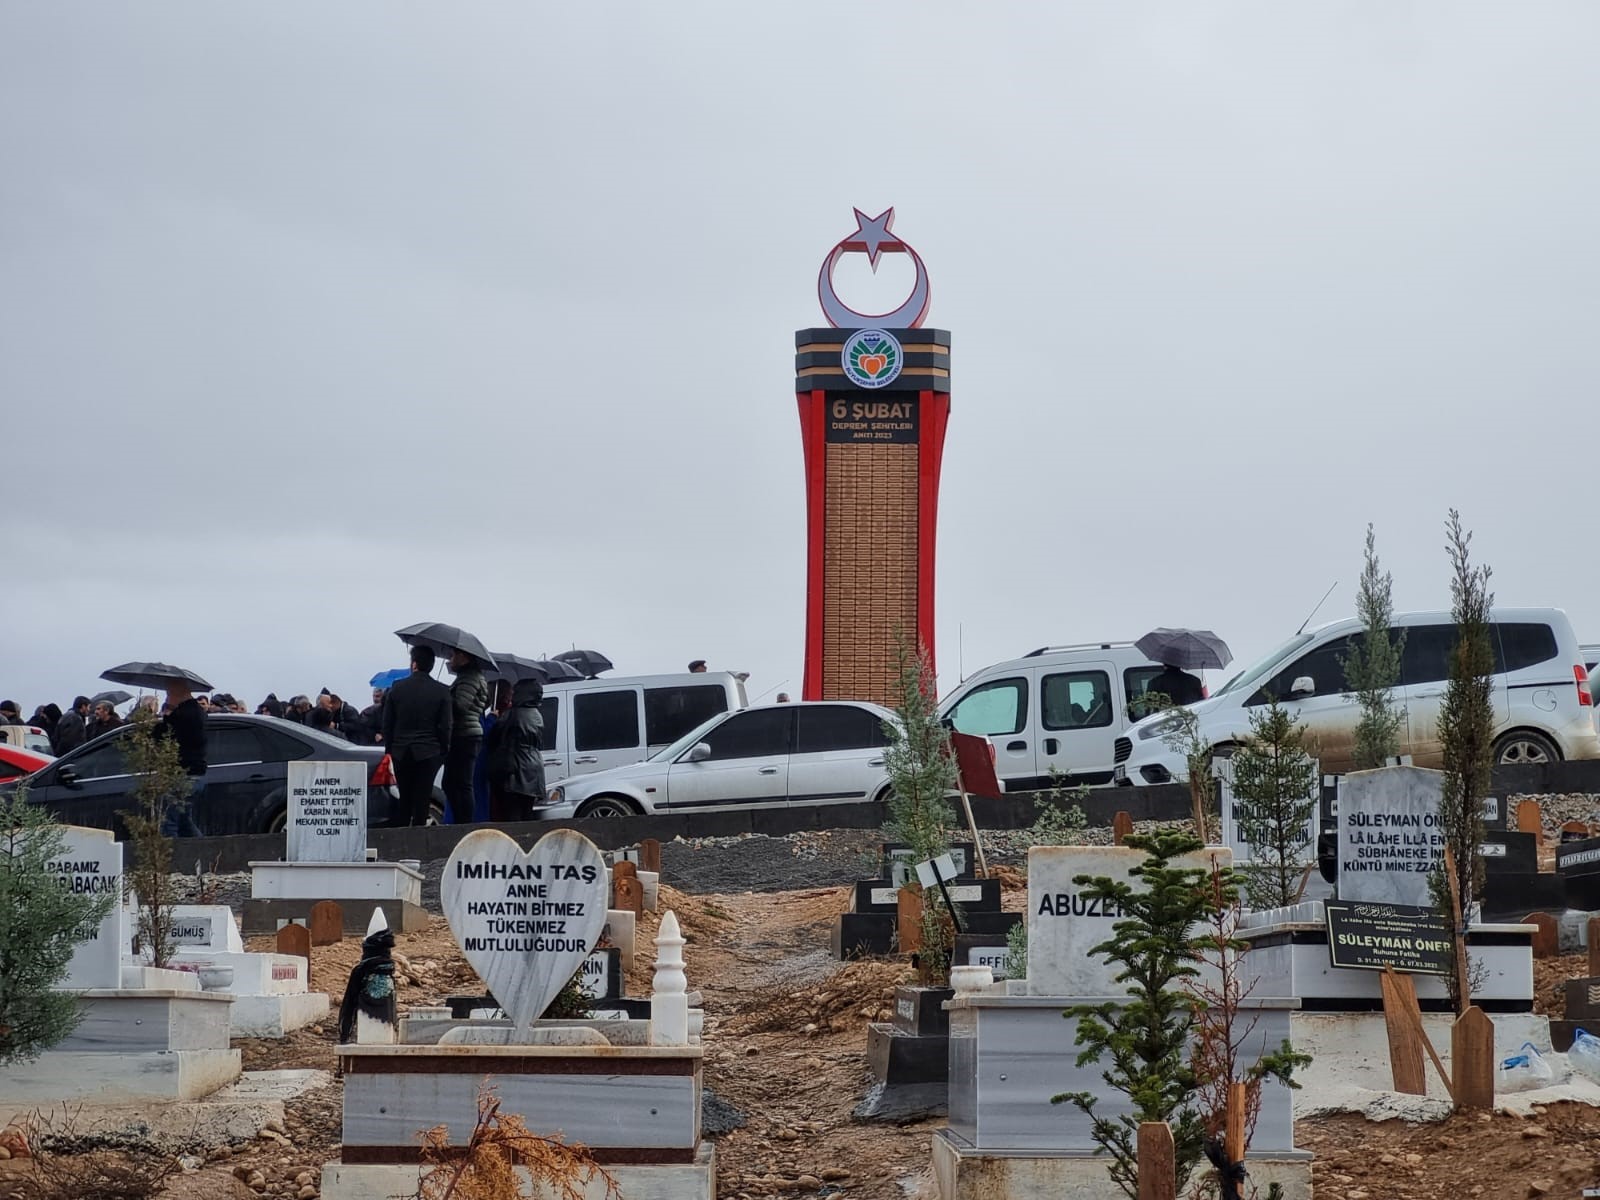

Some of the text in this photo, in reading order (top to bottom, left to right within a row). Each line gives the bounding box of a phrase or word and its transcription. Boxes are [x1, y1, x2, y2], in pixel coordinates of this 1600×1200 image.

[832, 399, 912, 421] 6 ŞUBAT
[831, 422, 868, 430] DEPREM
[310, 787, 327, 795] SENİ
[330, 787, 361, 795] RABBİME
[332, 797, 354, 805] ETTİM
[304, 807, 330, 815] KABRİN
[296, 818, 359, 826] MEKANIN CENNET
[1348, 812, 1448, 828] SÜLEYMAN ÖN
[316, 828, 340, 836] OLSUN
[1350, 832, 1365, 845] LÂ
[1367, 831, 1400, 845] İLÂHE
[1403, 832, 1428, 845] İLLÂ
[1358, 845, 1427, 859] SÜBHÂNEKE
[47, 861, 100, 873] BABAMIZ
[457, 861, 597, 884] İMİHAN TAŞ
[1344, 860, 1382, 872] KÜNTÜ
[507, 884, 547, 898] ANNE
[468, 900, 584, 916] HAYATIN BİTMEZ
[171, 925, 205, 940] GÜMÜŞ
[487, 917, 566, 934] TÜKENMEZ
[465, 936, 586, 952] MUTLULUĞUDUR
[1338, 932, 1451, 952] SÜLEYMAN ÖNER
[1373, 948, 1421, 958] Ruhuna Fatiha
[581, 957, 603, 975] KİN
[979, 954, 1010, 969] REFİ
